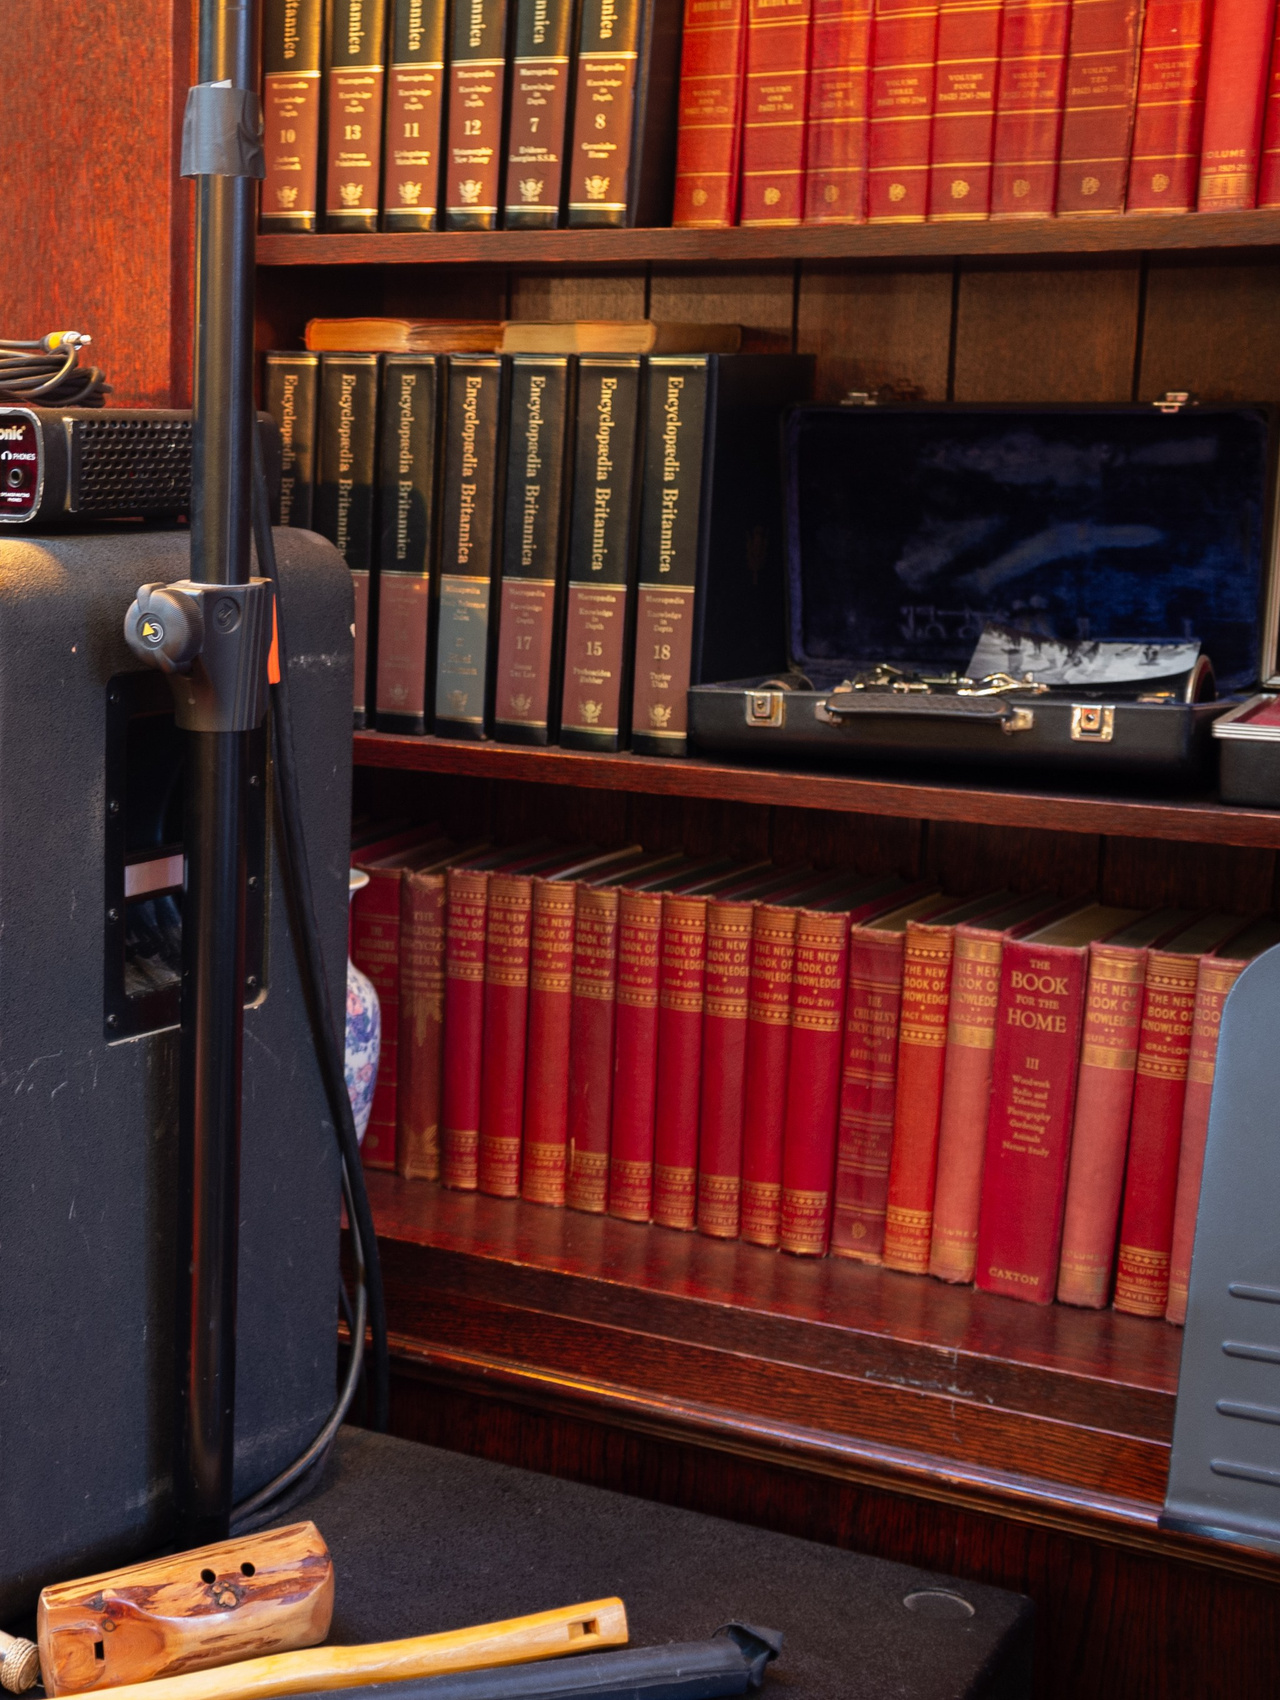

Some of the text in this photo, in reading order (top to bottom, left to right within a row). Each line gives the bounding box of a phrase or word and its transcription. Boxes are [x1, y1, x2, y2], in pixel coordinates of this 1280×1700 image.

[283, 0, 301, 59] tannica
[348, 0, 365, 54] annica
[408, 0, 425, 50] annica
[469, 0, 487, 47] nnica
[464, 119, 482, 136] 12
[529, 117, 540, 133] 7
[594, 113, 606, 130] 8
[280, 129, 296, 143] 10
[344, 124, 362, 140] 13
[404, 122, 419, 138] 11
[1206, 149, 1246, 159] OLUME
[398, 373, 417, 474] Encyclopædia
[12, 452, 36, 461] PHONES
[457, 375, 482, 564] Encyclopædia Britannica
[521, 375, 546, 566] Encyclopædia Britannica
[591, 377, 618, 571] Encyclopædia Britannica
[659, 376, 685, 573] Encyclopædia Britannica
[280, 477, 295, 527] Britan
[516, 635, 532, 650] 17
[586, 641, 603, 657] 15
[653, 644, 671, 661] 18
[512, 925, 525, 935] OF
[558, 930, 571, 940] OF
[682, 934, 703, 945] NEW
[707, 938, 748, 951] THE NEW
[644, 944, 657, 954] OF
[689, 947, 702, 957] OF
[707, 950, 746, 963] BOOK OF
[773, 946, 795, 957] NEW
[798, 948, 839, 963] THE NEW
[781, 959, 793, 970] OF
[797, 961, 838, 976] BOOK OF
[904, 964, 948, 978] THE NEW
[1029, 959, 1051, 970] THE
[904, 976, 946, 992] BOOK OF
[1011, 970, 1069, 995] BOOK
[1111, 984, 1138, 997] NEW
[1016, 994, 1060, 1010] FOR THE
[1149, 992, 1195, 1008] THE NEW
[921, 1013, 945, 1023] INDEX
[1007, 1007, 1067, 1033] HOME
[1086, 1012, 1136, 1028] NOWLEDGE
[1147, 1006, 1177, 1020] BOOK
[1142, 1019, 1193, 1036] KNOWLEDG
[1025, 1056, 1040, 1071] III
[1012, 1074, 1051, 1089] Woodwork
[1012, 1087, 1048, 1100] Radio and
[1013, 1096, 1047, 1109] Television
[1007, 1106, 1051, 1123] Photography
[1009, 1119, 1045, 1134] Gardening
[1013, 1132, 1041, 1144] Animals
[1002, 1141, 1050, 1158] Nature Study
[989, 1266, 1039, 1286] CAXTON
[1121, 1264, 1160, 1277] VOLUME
[1119, 1290, 1168, 1303] WAVERLEY
